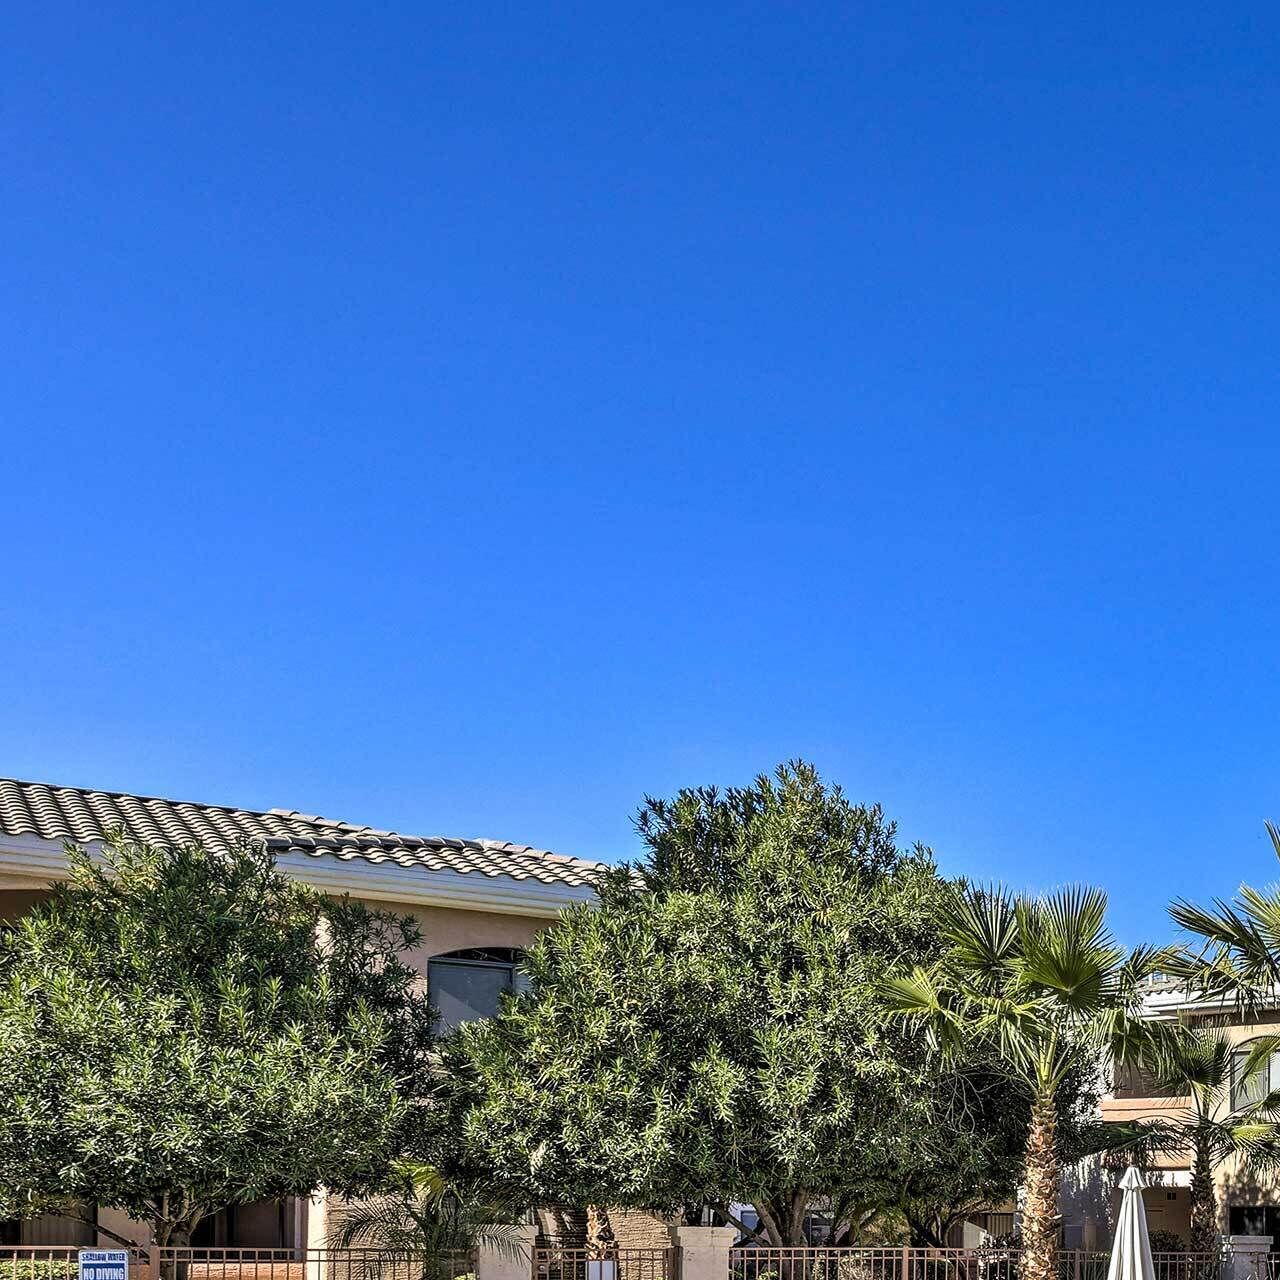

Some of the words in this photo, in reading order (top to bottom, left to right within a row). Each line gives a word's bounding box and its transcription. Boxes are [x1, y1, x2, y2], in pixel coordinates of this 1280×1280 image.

[108, 1253, 125, 1261] WATER
[83, 1268, 95, 1280] NO
[96, 1268, 124, 1280] DIVING
